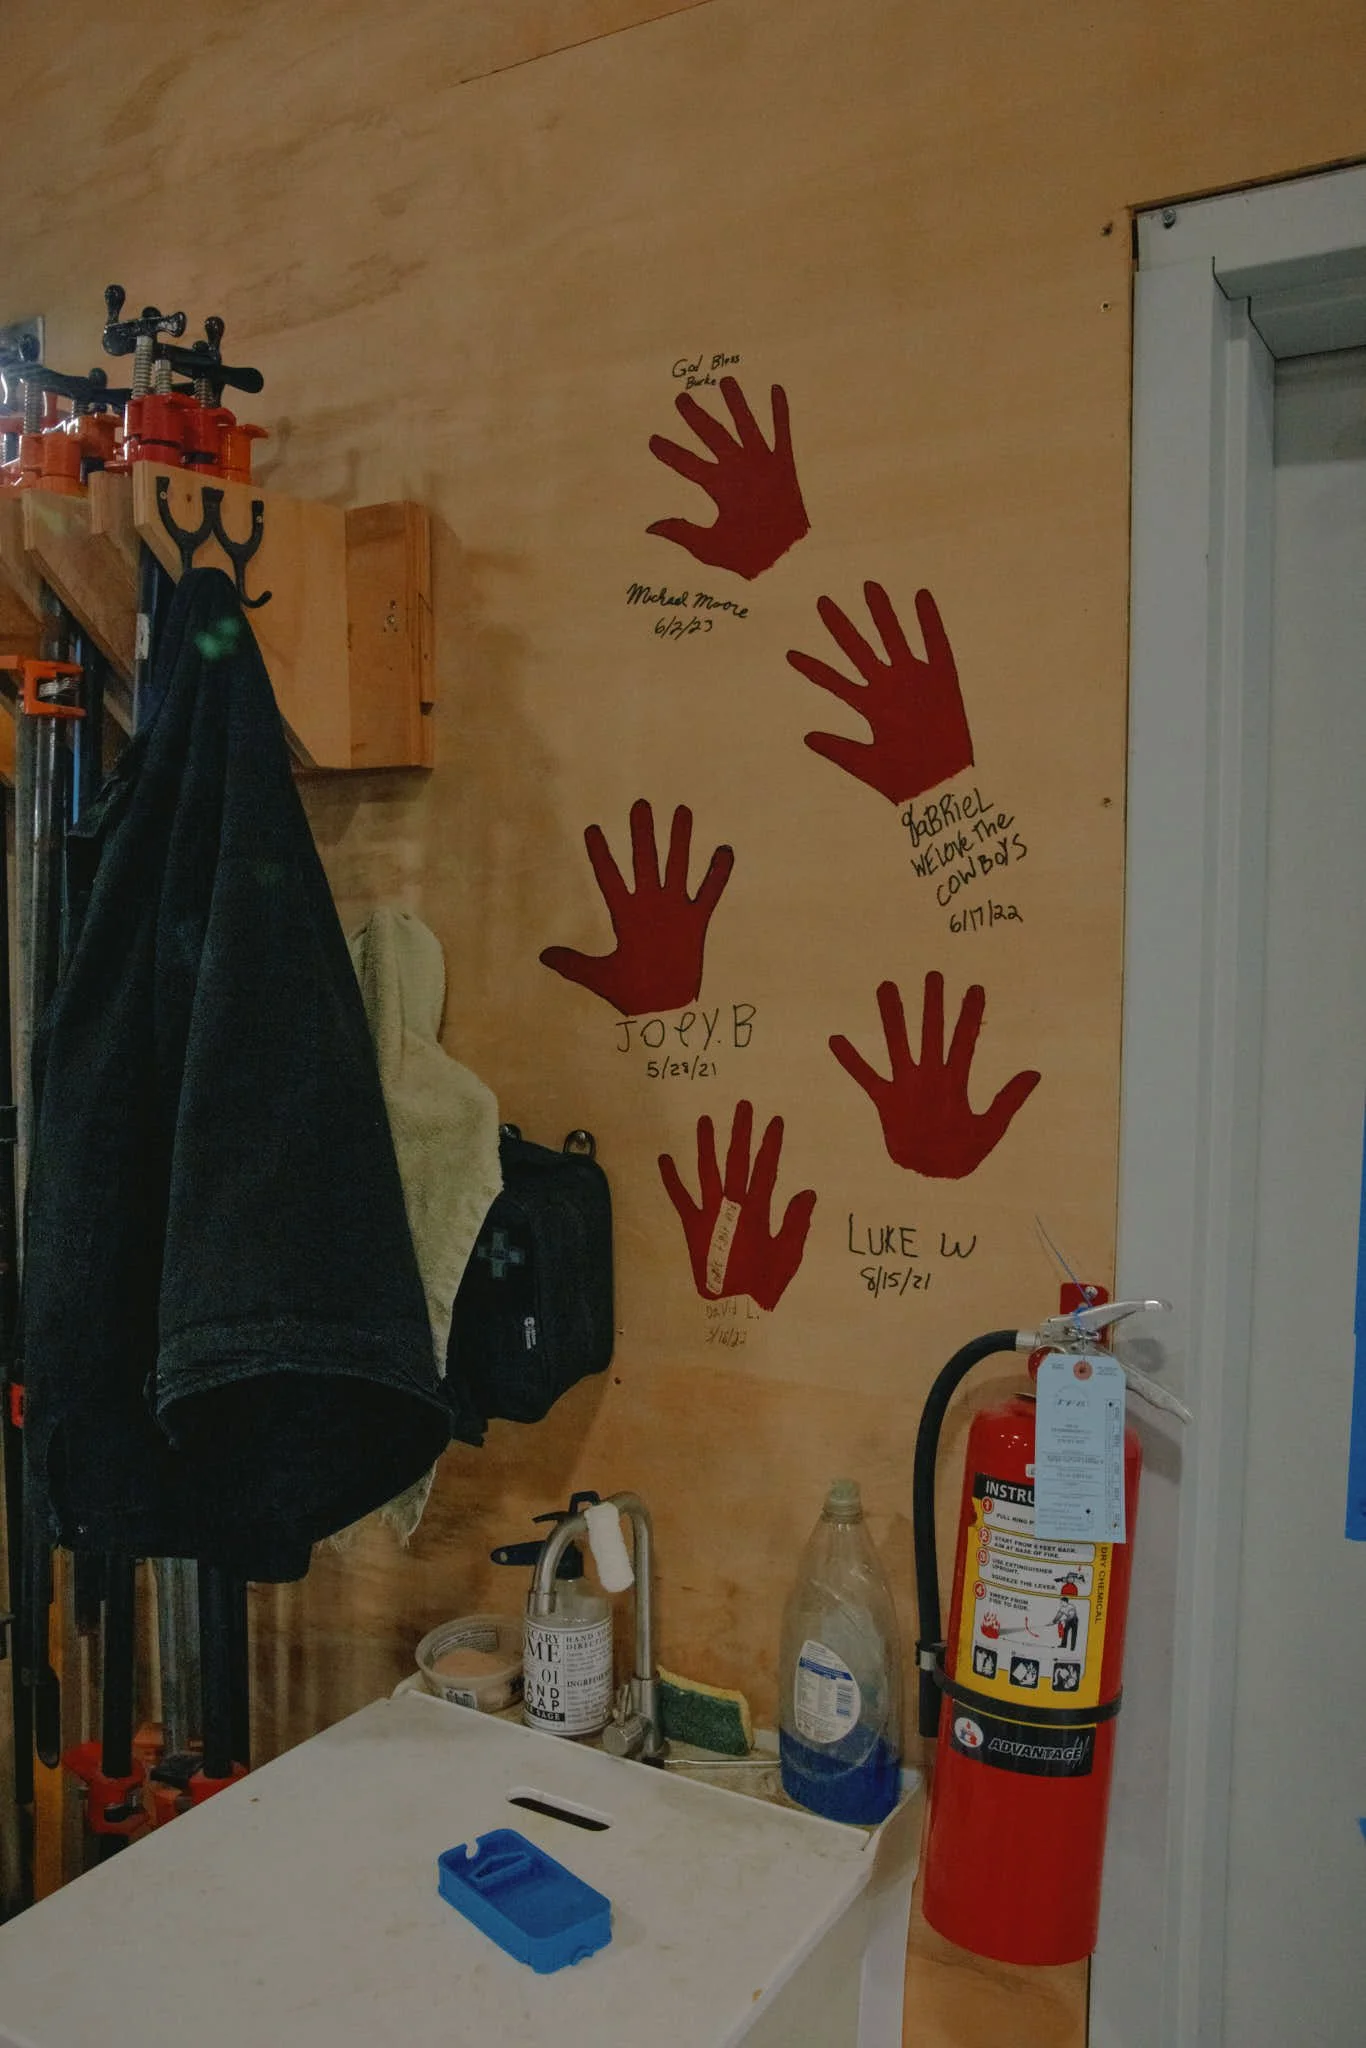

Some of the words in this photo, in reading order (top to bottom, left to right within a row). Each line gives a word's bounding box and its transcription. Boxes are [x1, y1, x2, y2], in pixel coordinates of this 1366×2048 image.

[672, 354, 703, 377] God
[693, 592, 749, 618] Moore
[950, 899, 1023, 933] 6/17/22
[849, 1212, 918, 1258] LUKE
[860, 1265, 930, 1298] 8/15/21
[994, 1535, 1012, 1543] START
[1015, 1540, 1033, 1548] FROM
[1005, 1560, 1053, 1574] EXTINGUISHER
[1095, 1570, 1106, 1624] CHEMICAL
[988, 1736, 1082, 1761] ADVANTAGE
